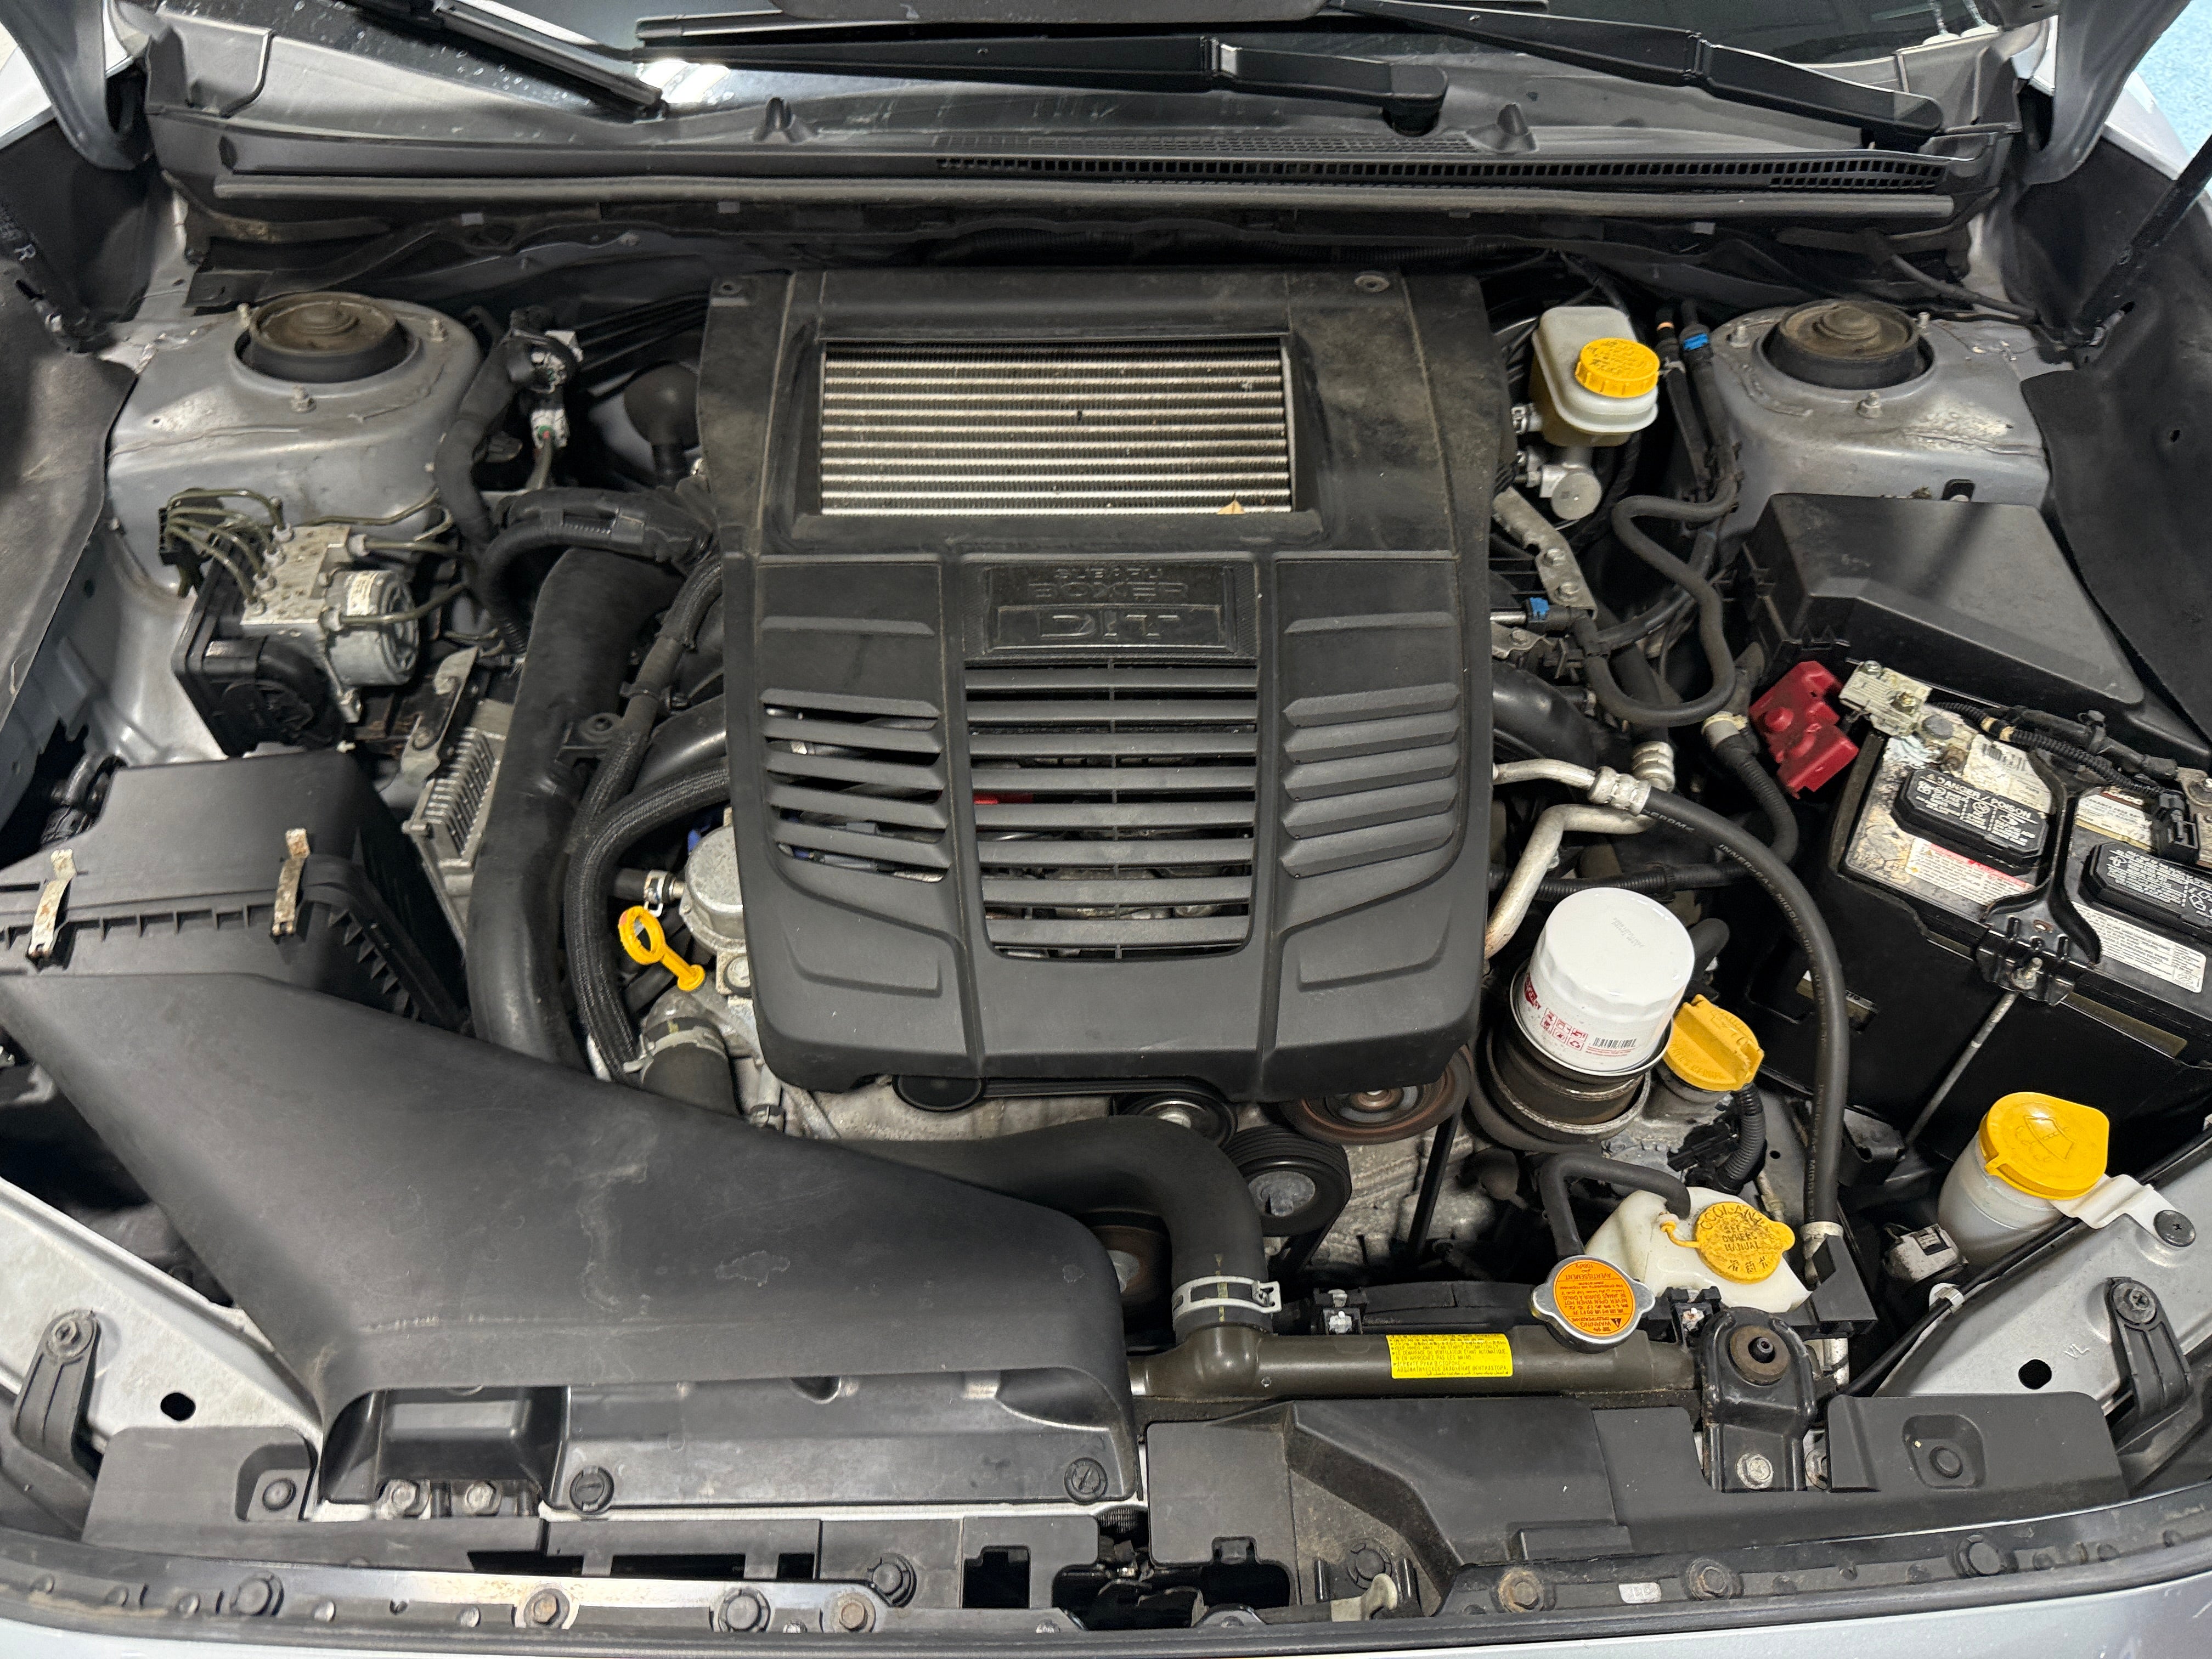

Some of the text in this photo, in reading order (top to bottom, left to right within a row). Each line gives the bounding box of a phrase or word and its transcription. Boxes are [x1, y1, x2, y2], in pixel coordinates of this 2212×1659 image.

[1054, 567, 1162, 579] SUBARU
[1029, 582, 1189, 599] BOXER
[1039, 613, 1181, 640] DIT
[1990, 797, 2032, 820] POISON
[1701, 1205, 1766, 1229] COOLANT
[1724, 1224, 1741, 1233] SEE
[1724, 1241, 1761, 1251] MANUAL
